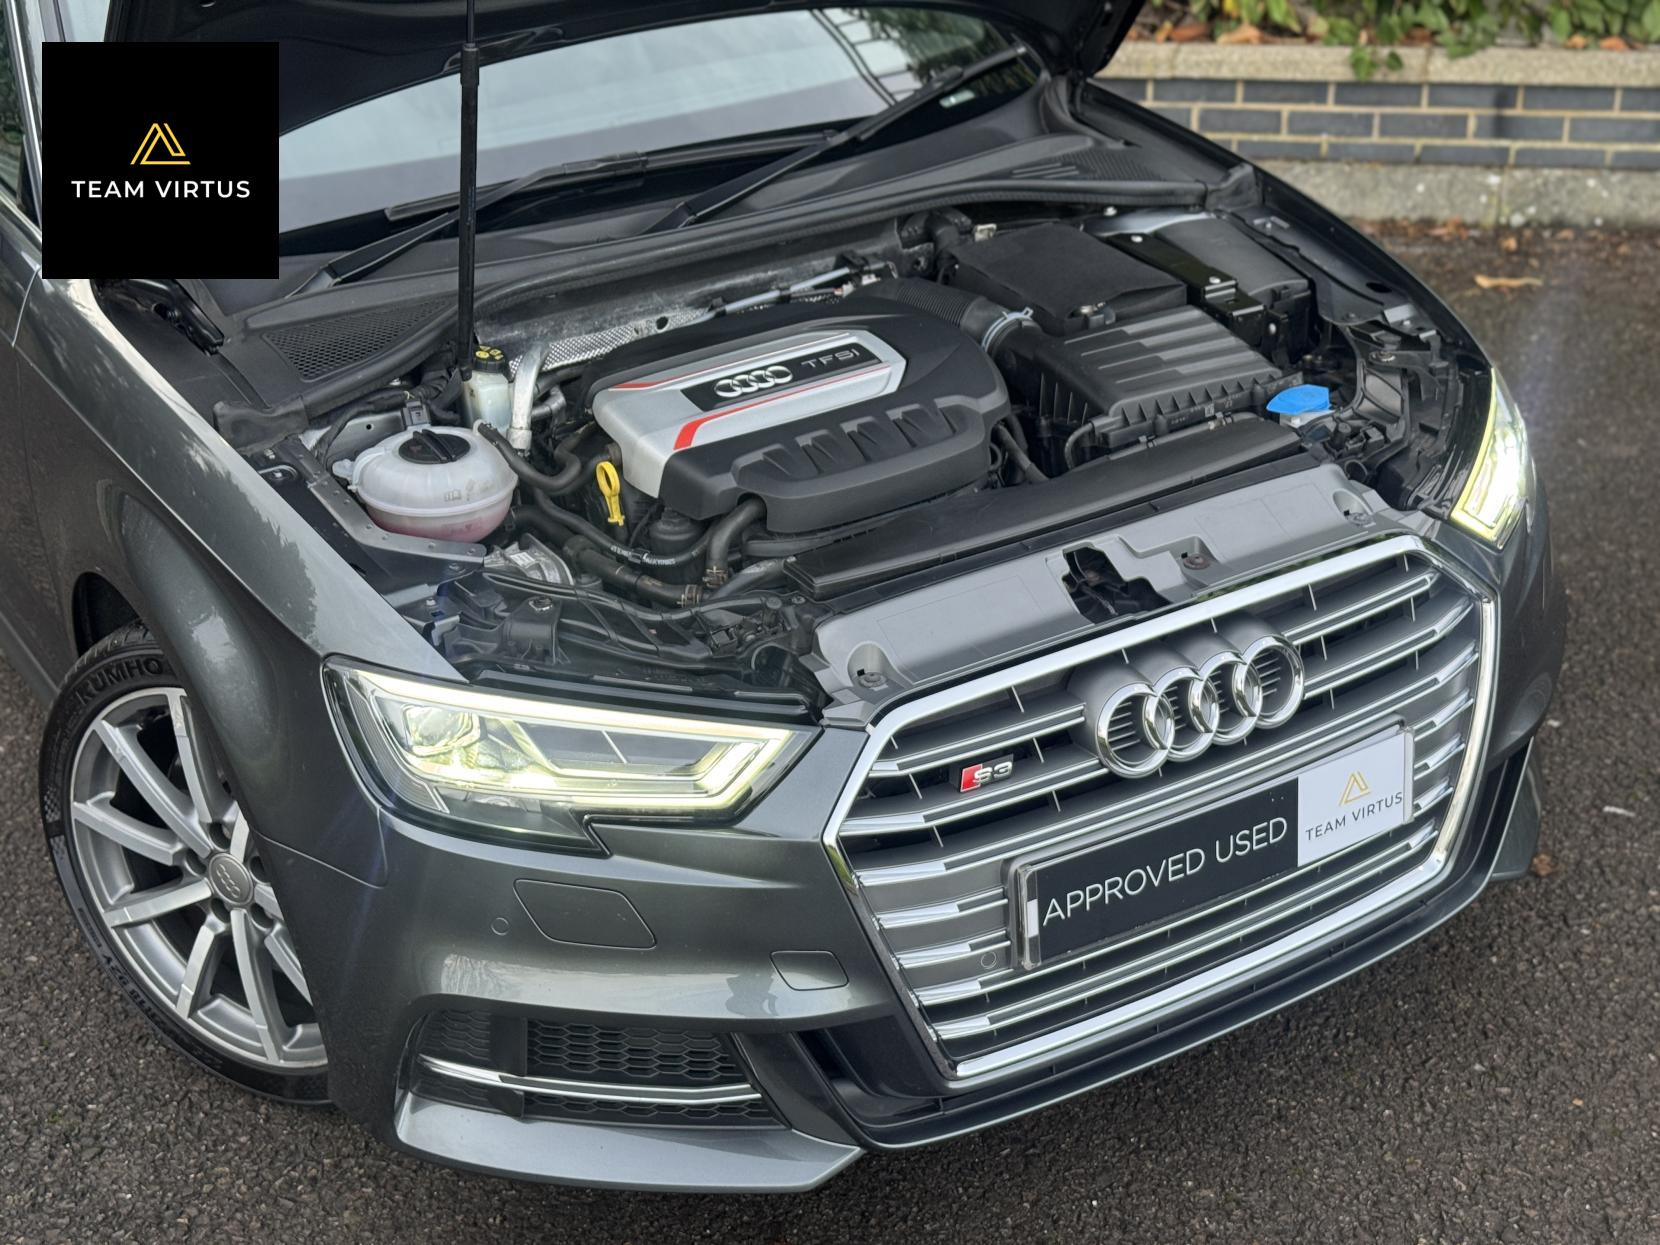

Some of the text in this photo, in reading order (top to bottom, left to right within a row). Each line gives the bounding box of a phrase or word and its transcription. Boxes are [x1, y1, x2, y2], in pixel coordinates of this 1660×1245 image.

[800, 348, 860, 368] TFSI
[74, 657, 164, 706] KUMHO
[971, 760, 1013, 786] S3
[1305, 791, 1403, 841] TEAM VIRTUS
[1042, 816, 1288, 927] APPROVED USED
